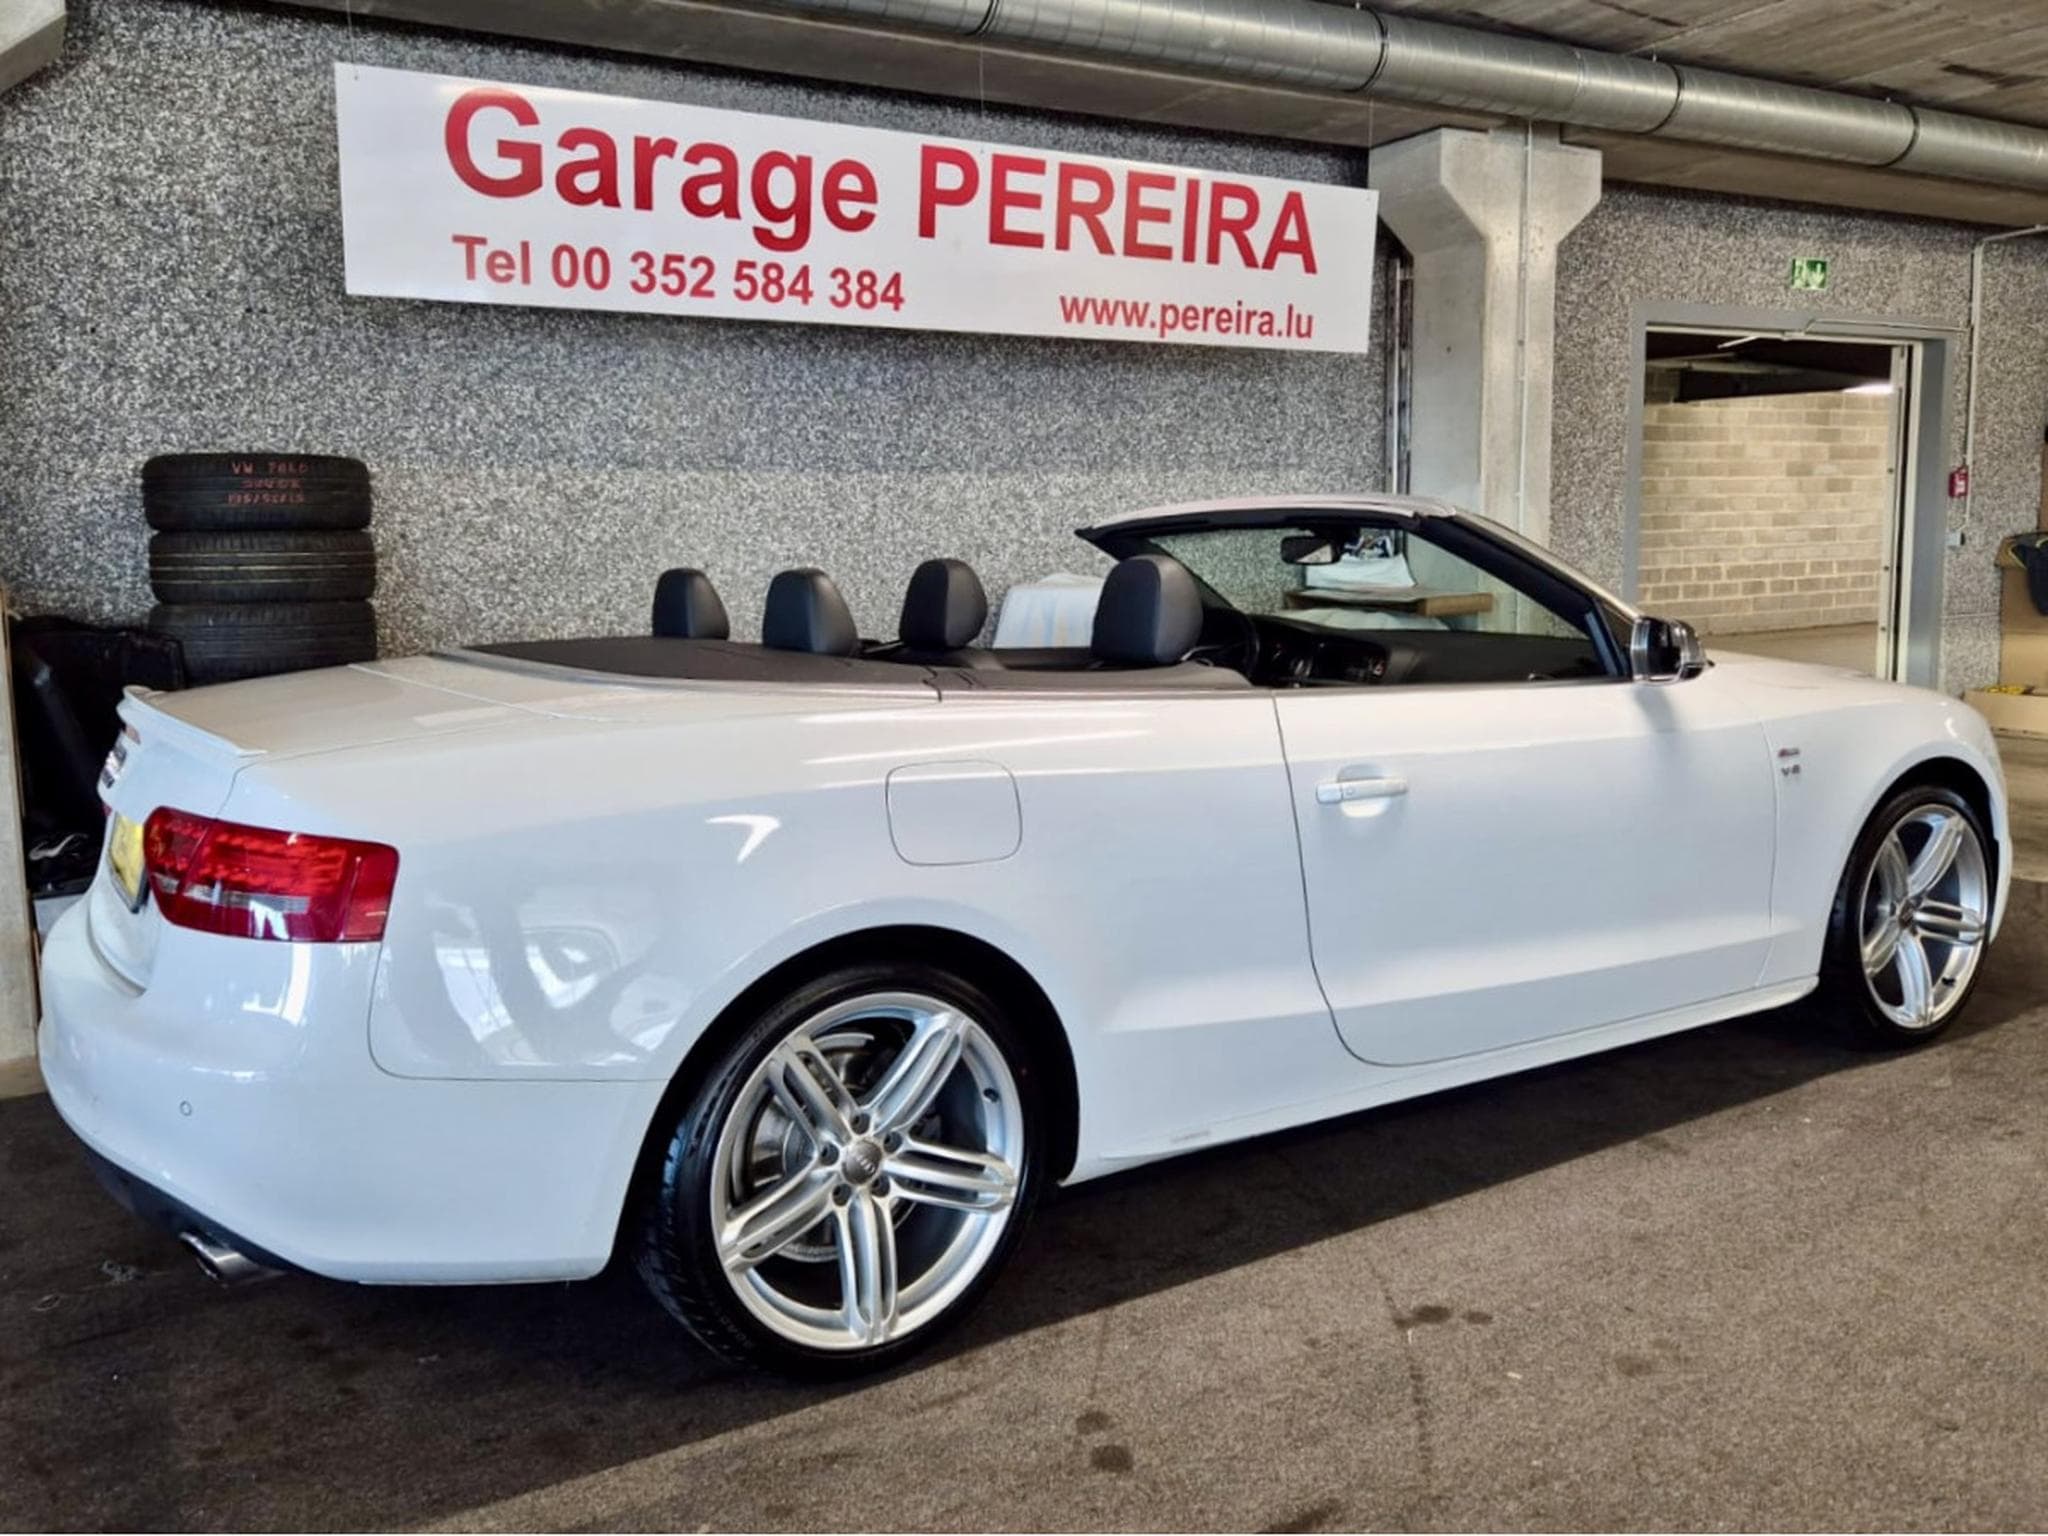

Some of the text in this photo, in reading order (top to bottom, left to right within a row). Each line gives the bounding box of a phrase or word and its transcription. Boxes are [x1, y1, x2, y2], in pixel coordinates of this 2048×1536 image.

[445, 88, 1318, 275] Garage PEREIRA
[452, 234, 905, 312] Tel 00 352 584 384
[1060, 295, 1314, 339] www.pereira.lu
